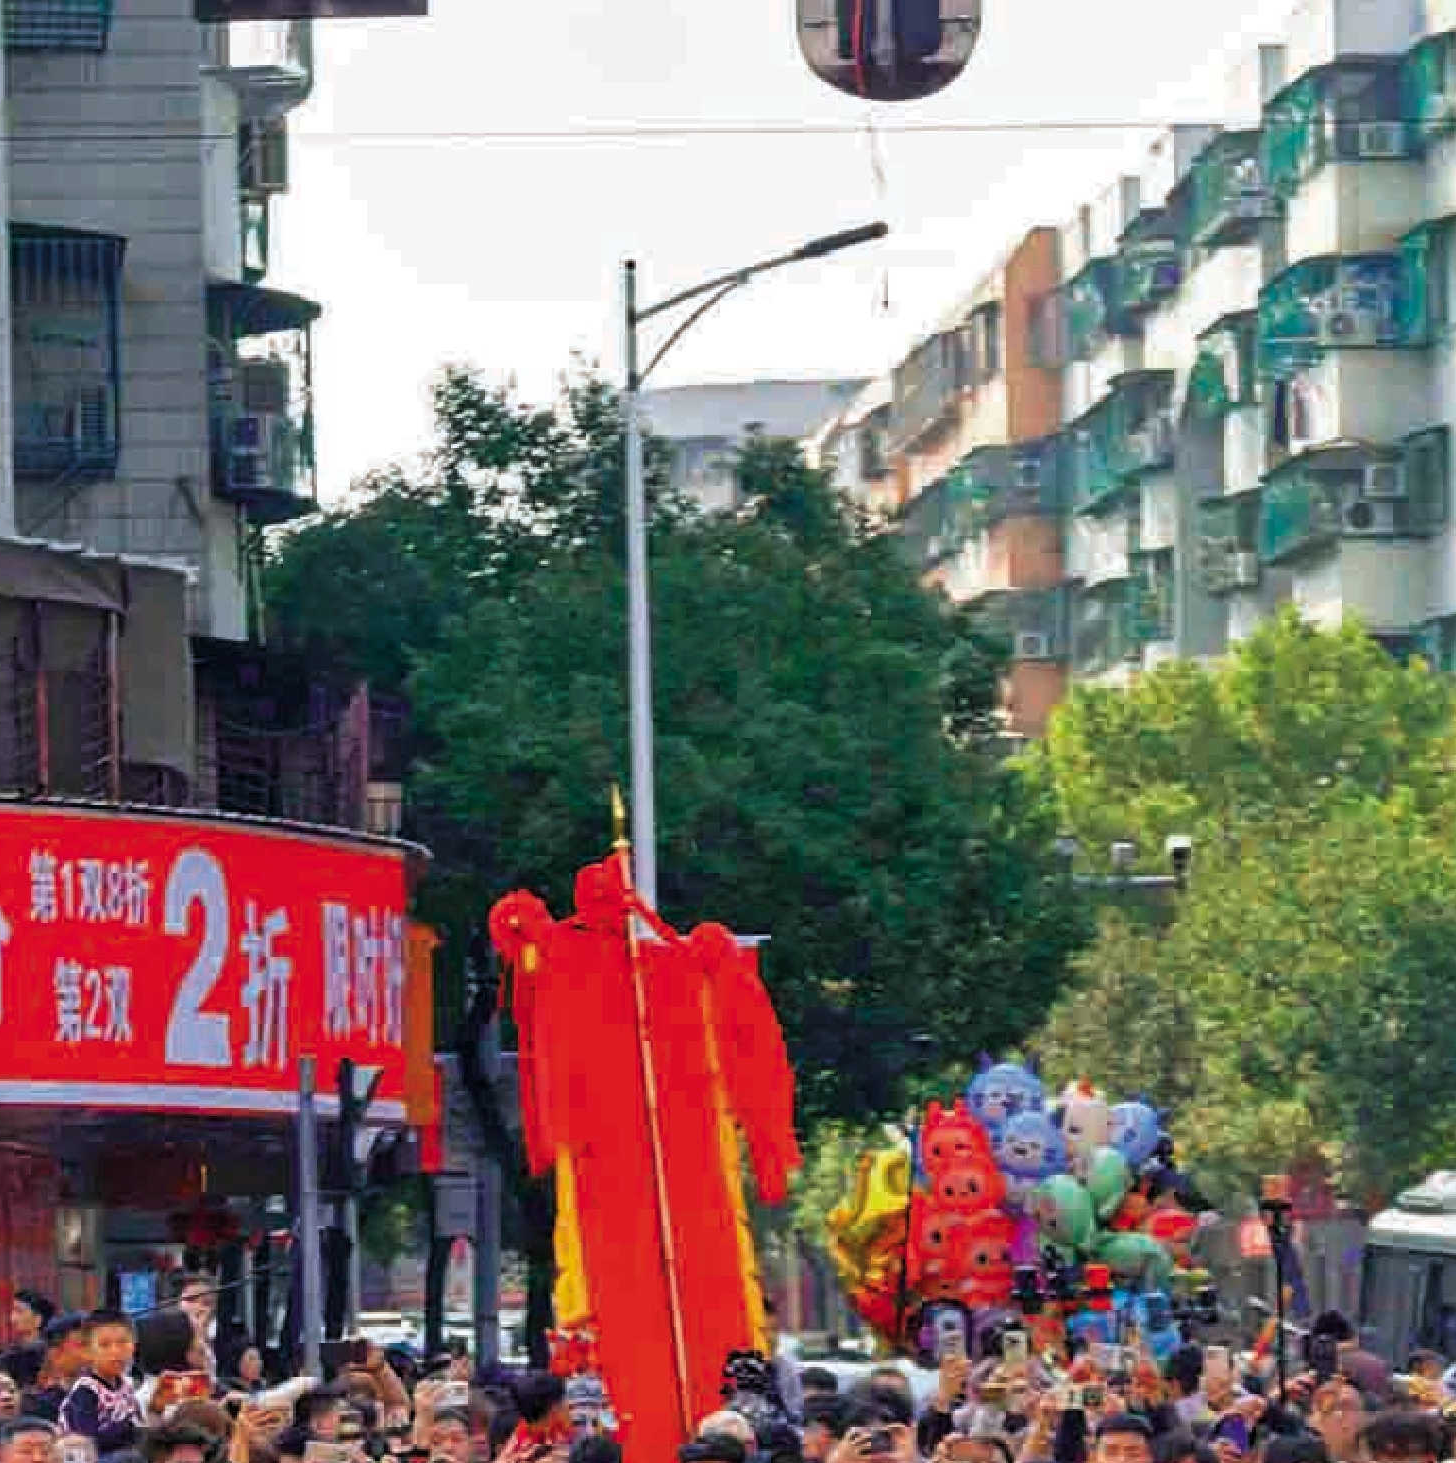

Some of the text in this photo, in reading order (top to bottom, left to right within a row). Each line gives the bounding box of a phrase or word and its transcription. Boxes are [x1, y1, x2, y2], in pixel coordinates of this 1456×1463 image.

[30, 850, 151, 926] 第1双8折
[55, 957, 133, 1043] 第2双
[164, 846, 292, 1070] 2折
